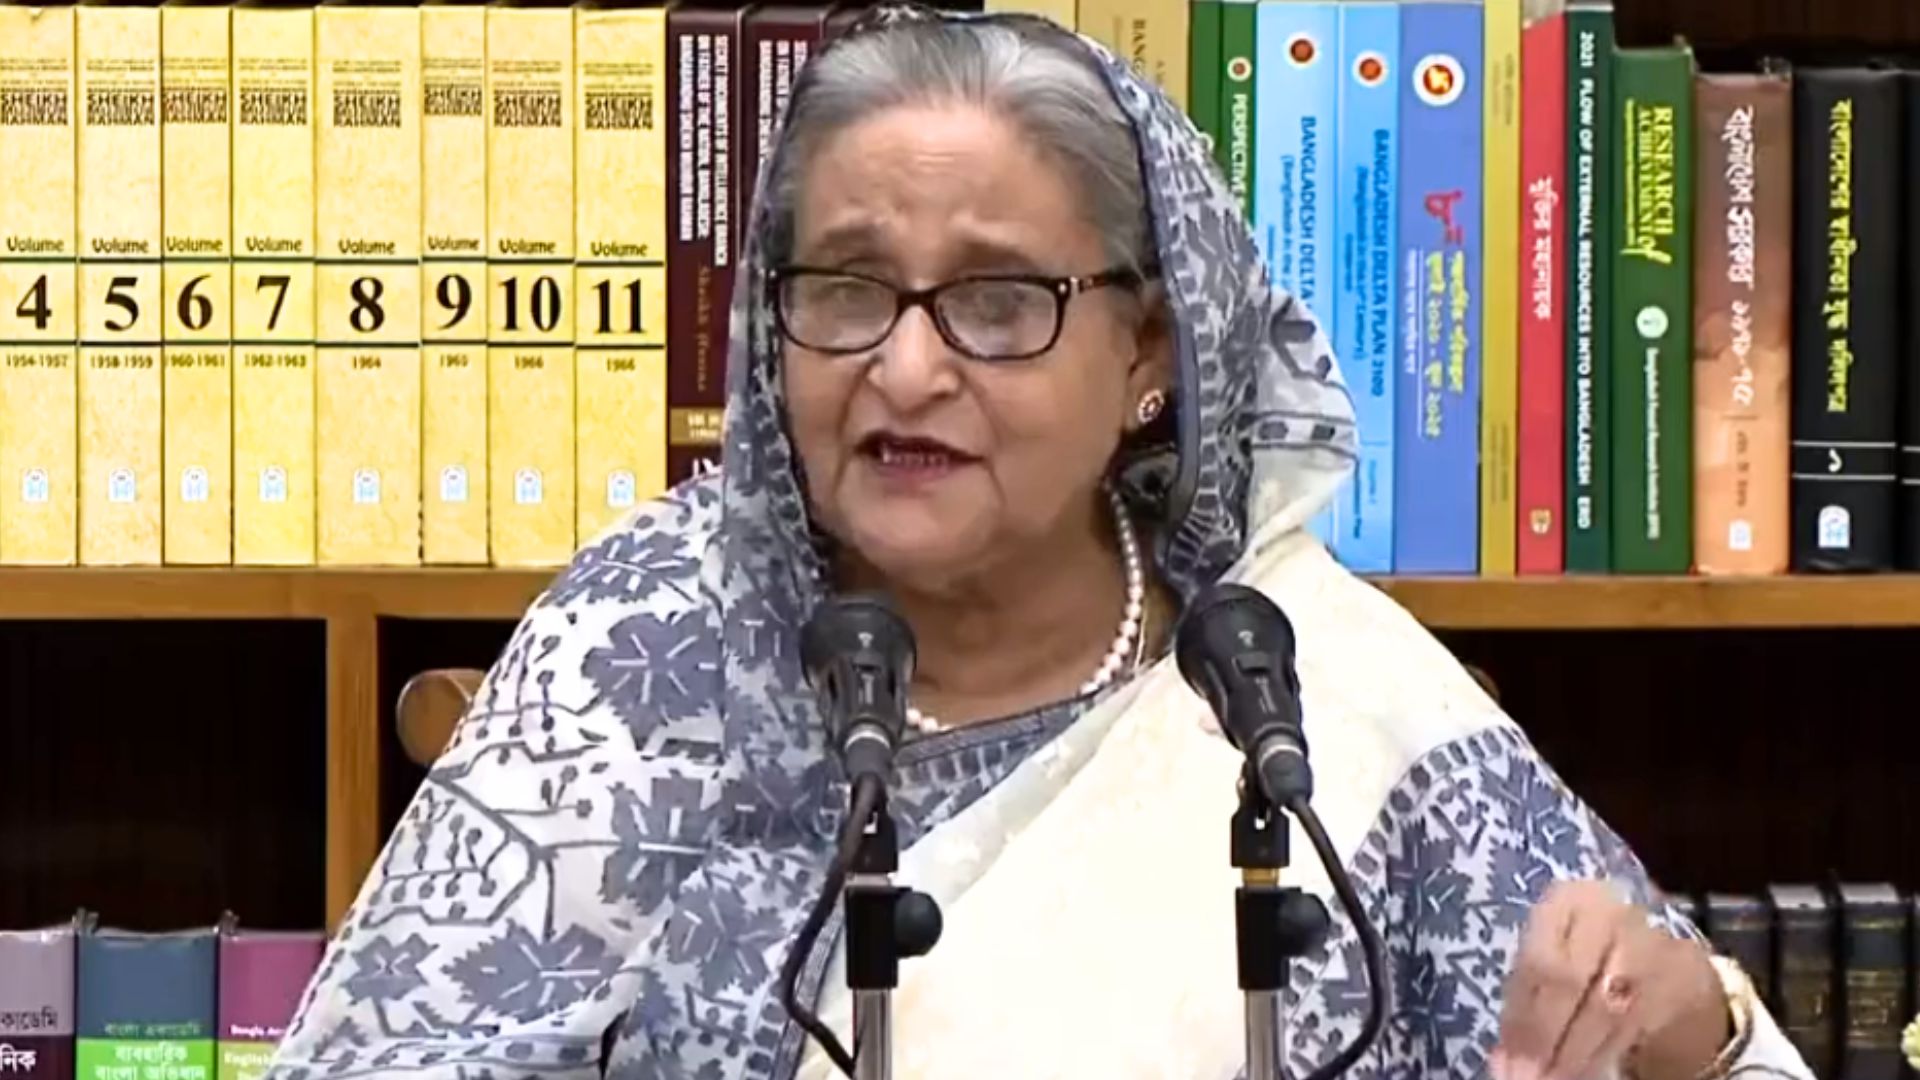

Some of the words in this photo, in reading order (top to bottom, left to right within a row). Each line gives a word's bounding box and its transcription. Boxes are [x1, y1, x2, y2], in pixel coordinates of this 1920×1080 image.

[1580, 32, 1594, 67] 2021
[1579, 78, 1594, 126] FLOW
[1579, 129, 1593, 150] OF
[1721, 105, 1755, 203] বাংলাদেশ
[1301, 116, 1316, 239] BANGLADESH
[1374, 128, 1391, 247] BANGLADESH
[1578, 154, 1593, 237] EXTERNAL
[1653, 106, 1674, 235] RESEARCH
[7, 237, 63, 252] Volume
[92, 239, 148, 254] Volume
[166, 237, 223, 252] Volume
[246, 237, 302, 252] Volume
[338, 240, 395, 255] Volume
[428, 236, 479, 251] Volume
[499, 240, 555, 255] Volume
[591, 242, 647, 258] Volume
[1726, 206, 1755, 291] সরকার
[1300, 244, 1315, 300] DELTA
[1372, 250, 1389, 305] DELTA
[1578, 239, 1592, 334] RESOURCES
[16, 275, 52, 330] 4
[104, 277, 139, 331] 5
[177, 274, 213, 330] 6
[256, 275, 291, 330] 7
[350, 277, 385, 332] 8
[436, 274, 472, 330] 9
[499, 276, 561, 332] 10
[593, 279, 645, 334] 11
[1371, 309, 1387, 355] PLAN
[1578, 336, 1592, 375] INTO
[1371, 360, 1385, 397] 2100
[1577, 378, 1591, 485] BANGLADESH
[1577, 496, 1591, 530] ERD
[0, 1006, 58, 1030] কাডেমি
[0, 1043, 37, 1074] নিক
